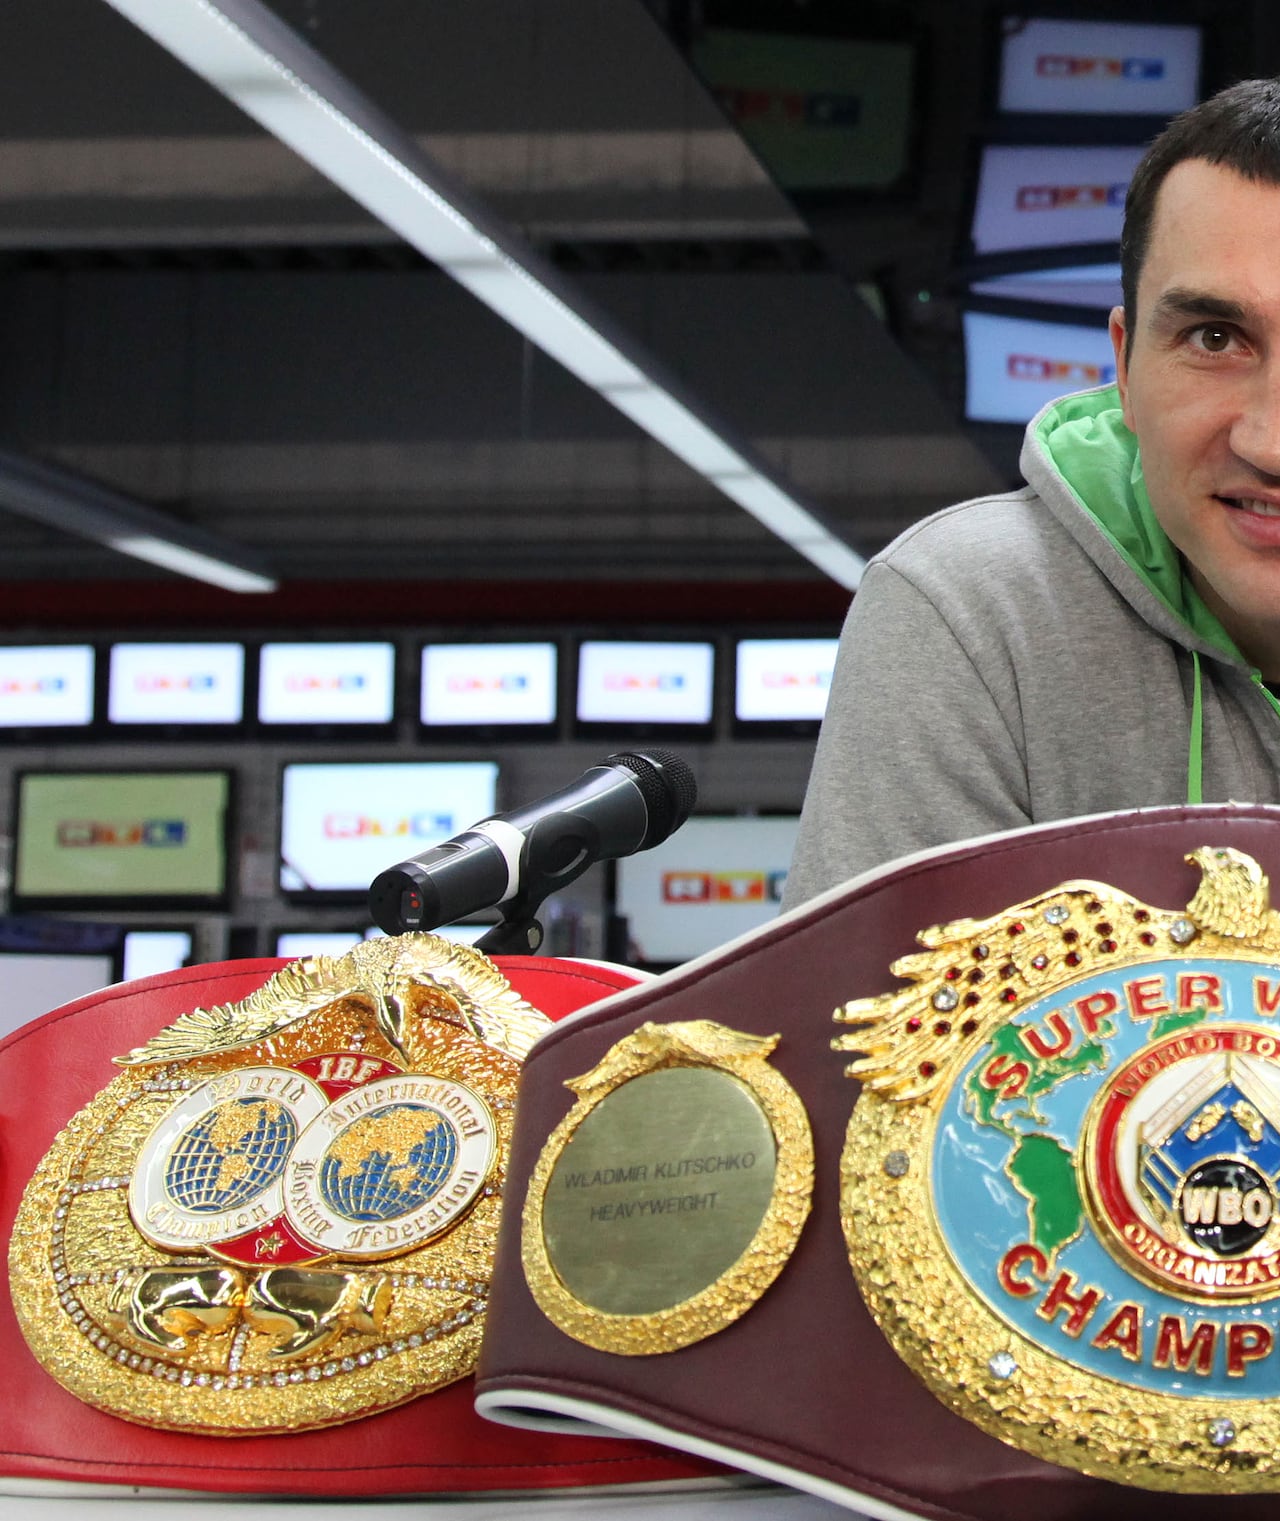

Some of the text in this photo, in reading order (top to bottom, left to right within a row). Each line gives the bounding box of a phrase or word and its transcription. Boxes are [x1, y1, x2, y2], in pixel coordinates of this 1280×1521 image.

[981, 974, 1222, 1100] SUPER
[318, 1056, 384, 1083] IBF
[1117, 1033, 1218, 1097] WORLD
[206, 1074, 308, 1105] World
[323, 1080, 487, 1141] International
[564, 1152, 756, 1189] WLADIMIR KLITSCHKO
[145, 1201, 271, 1241] Champion
[345, 1168, 480, 1250] Federation
[589, 1192, 720, 1222] HEAVYWEIGHT
[1182, 1186, 1273, 1228] WBO
